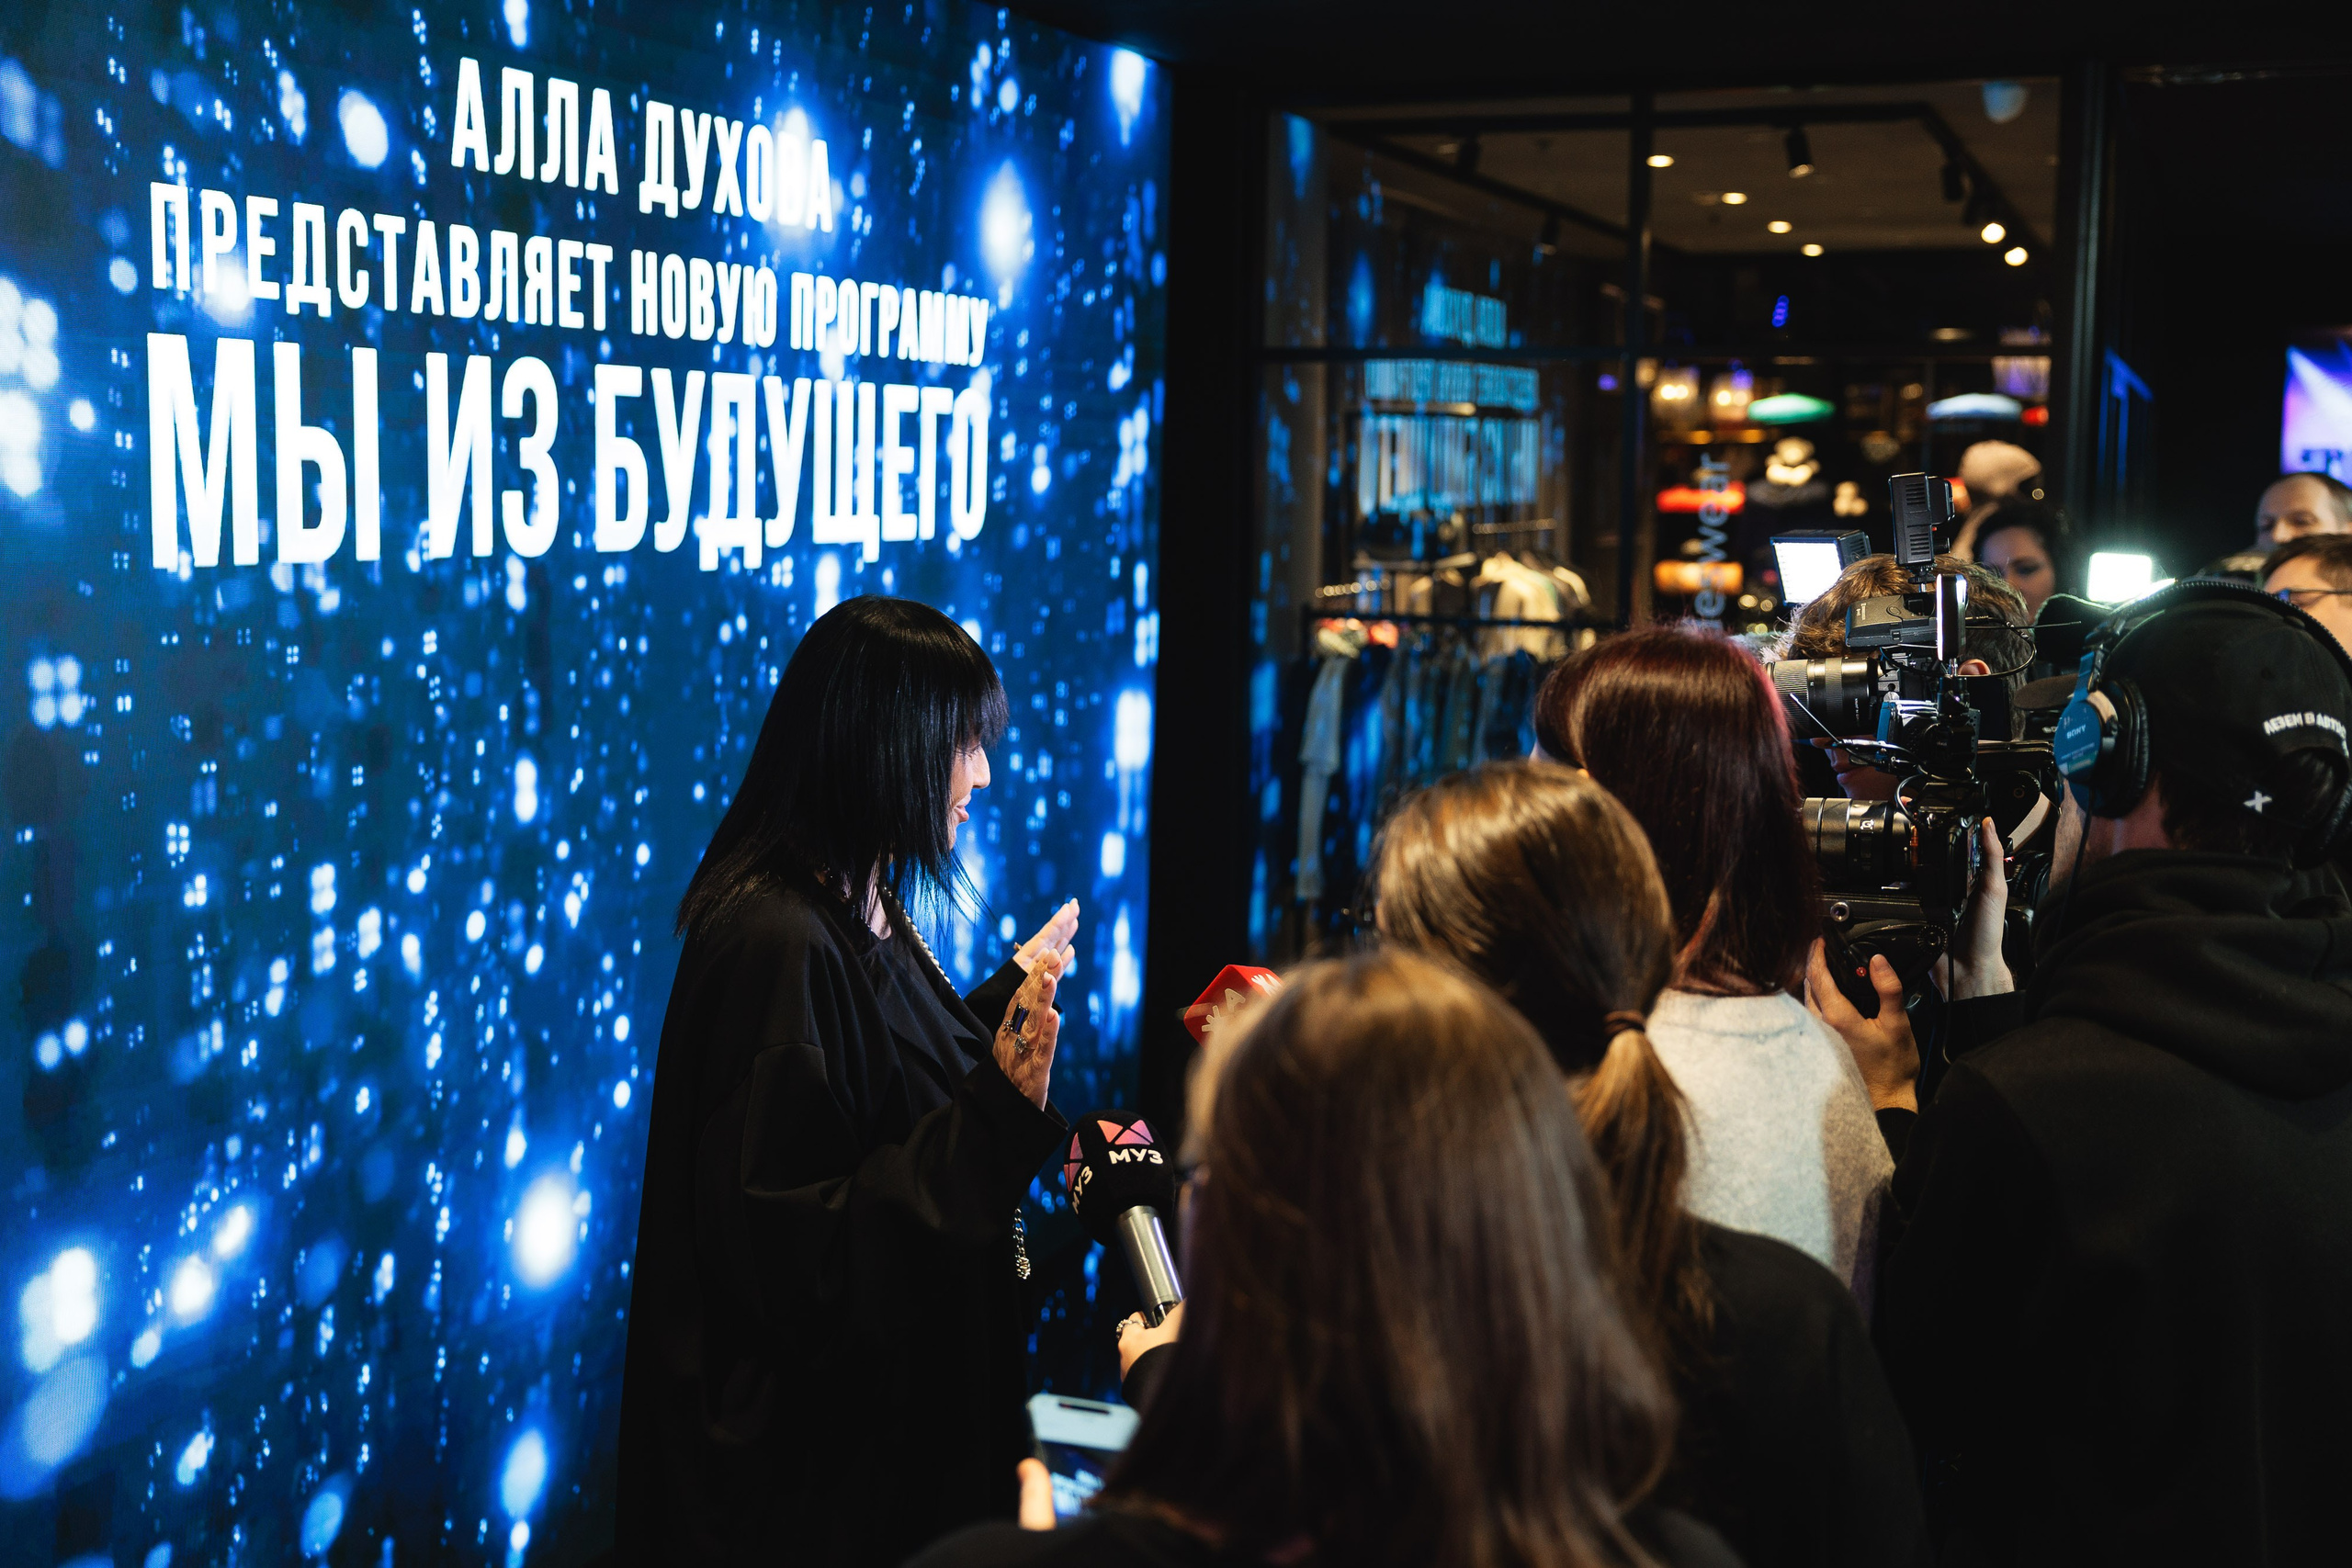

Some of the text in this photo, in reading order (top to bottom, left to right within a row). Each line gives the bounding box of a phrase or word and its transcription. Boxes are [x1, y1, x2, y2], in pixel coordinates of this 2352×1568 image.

[451, 57, 834, 233] АЛЛА ДУХОВА
[149, 181, 991, 368] ПРЕДСТАВЛЯЕТ НОВУЮ ПРОГРАММУ
[146, 332, 990, 571] МЫ ИЗ БУДУЩЕГО
[1072, 1166, 1093, 1214] МУЗ
[1108, 1148, 1164, 1165] МУЗ
